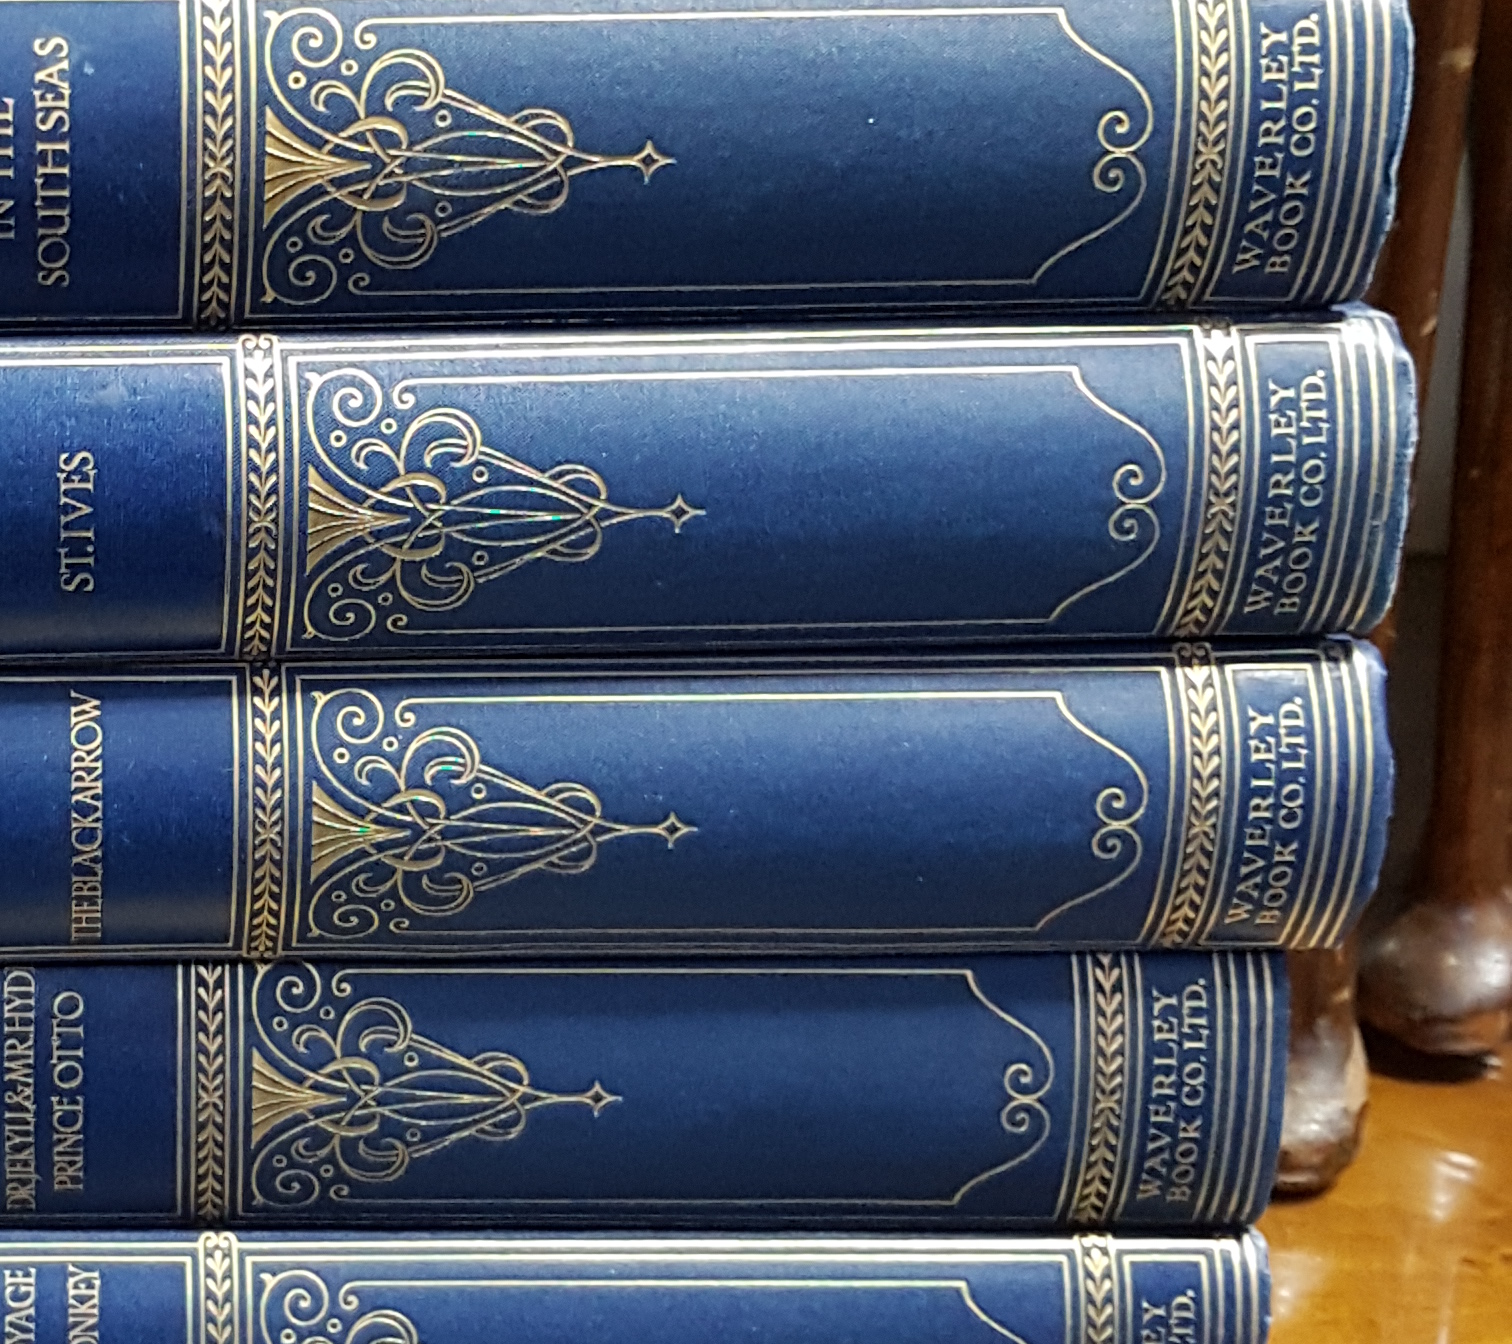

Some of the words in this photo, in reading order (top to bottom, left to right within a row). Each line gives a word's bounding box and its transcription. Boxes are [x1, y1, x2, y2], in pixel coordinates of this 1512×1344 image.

[33, 37, 71, 132] SEAS
[1291, 13, 1323, 91] LTD.
[1232, 22, 1289, 274] WAVERLEY
[1289, 99, 1319, 157] CO.
[35, 141, 71, 287] SOUTH
[1264, 170, 1312, 274] BOOK
[1299, 369, 1330, 445] LTD.
[1243, 379, 1298, 613] WAVERLEY
[1299, 452, 1327, 507] CO.
[1273, 518, 1320, 614] BOOK
[1278, 697, 1309, 769] LTD.
[1224, 705, 1276, 924] WAVERLEY
[1279, 776, 1306, 829] CO.
[1254, 840, 1298, 925] BOOK
[51, 991, 84, 1088] OTTO
[1181, 978, 1209, 1049] LTD.
[1136, 987, 1179, 1200] WAVERLEY
[1182, 1056, 1206, 1106] CO.
[51, 1096, 84, 1190] PRINCE
[1166, 1115, 1203, 1202] BOOK
